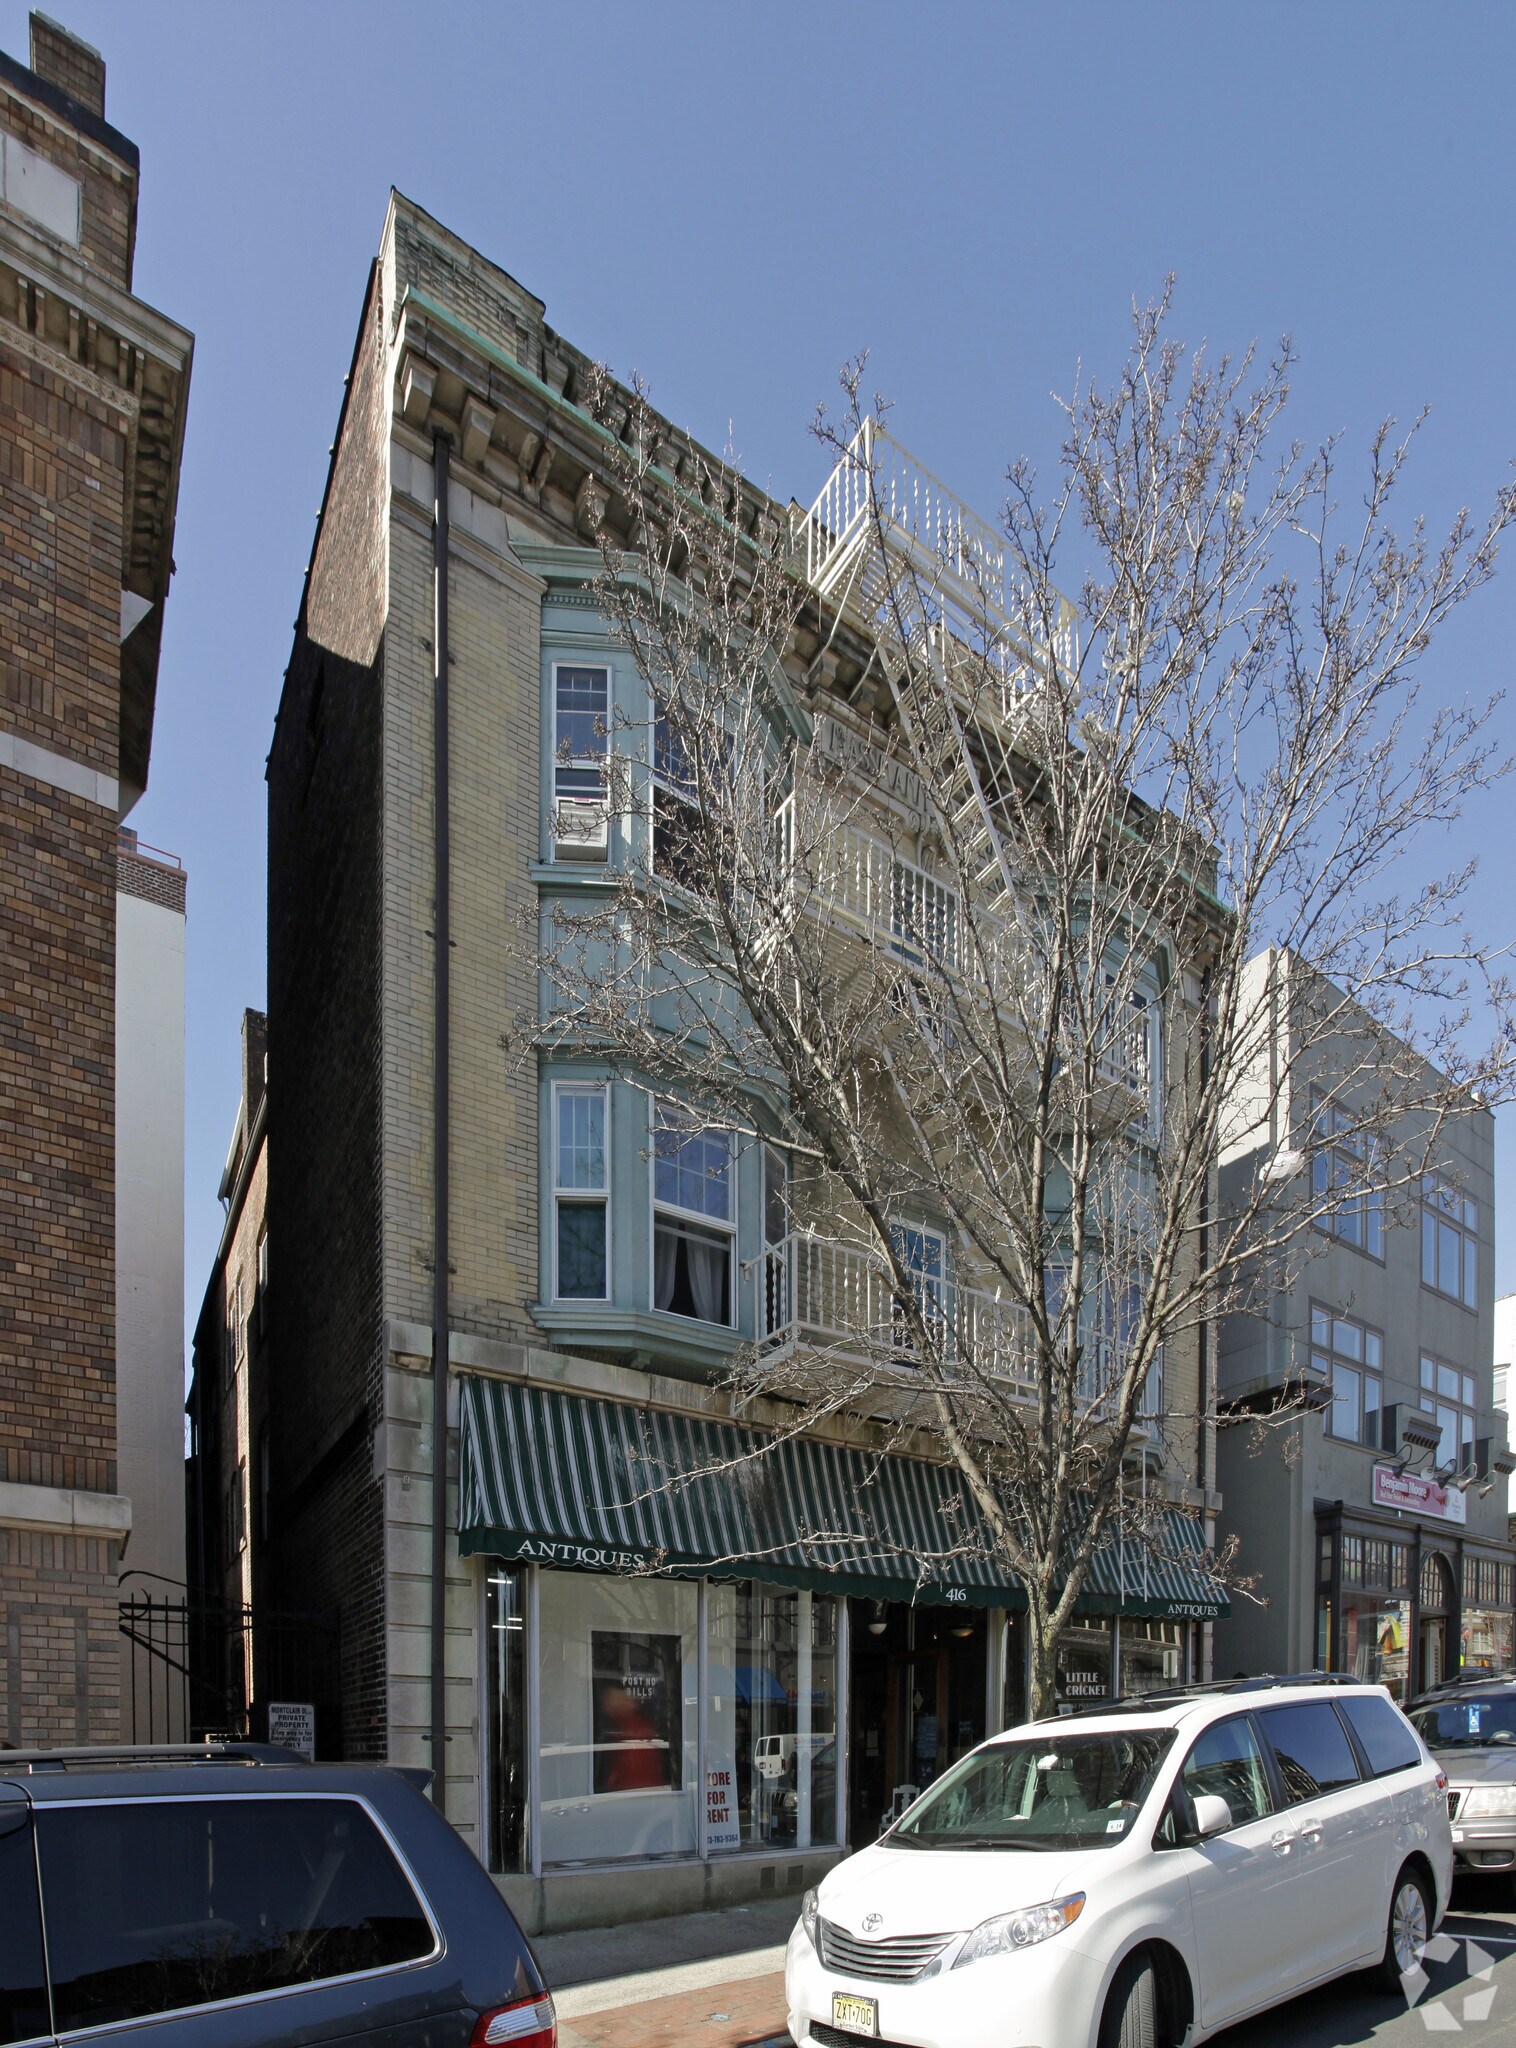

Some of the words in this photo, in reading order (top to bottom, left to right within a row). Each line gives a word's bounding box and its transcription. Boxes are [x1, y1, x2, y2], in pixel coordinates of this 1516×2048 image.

[1381, 1474, 1408, 1492] Benjamin
[1408, 1481, 1427, 1498] Moore
[516, 1539, 645, 1568] ANTIQUES
[945, 1588, 967, 1602] 416
[1167, 1603, 1219, 1617] ANTIQUES
[622, 1676, 643, 1686] POST
[645, 1677, 656, 1686] NO
[1066, 1672, 1098, 1683] LITTLE
[626, 1687, 653, 1696] BILLS
[1065, 1685, 1107, 1696] CRICKET
[706, 1791, 726, 1806] FOR
[706, 1808, 730, 1824] RENT
